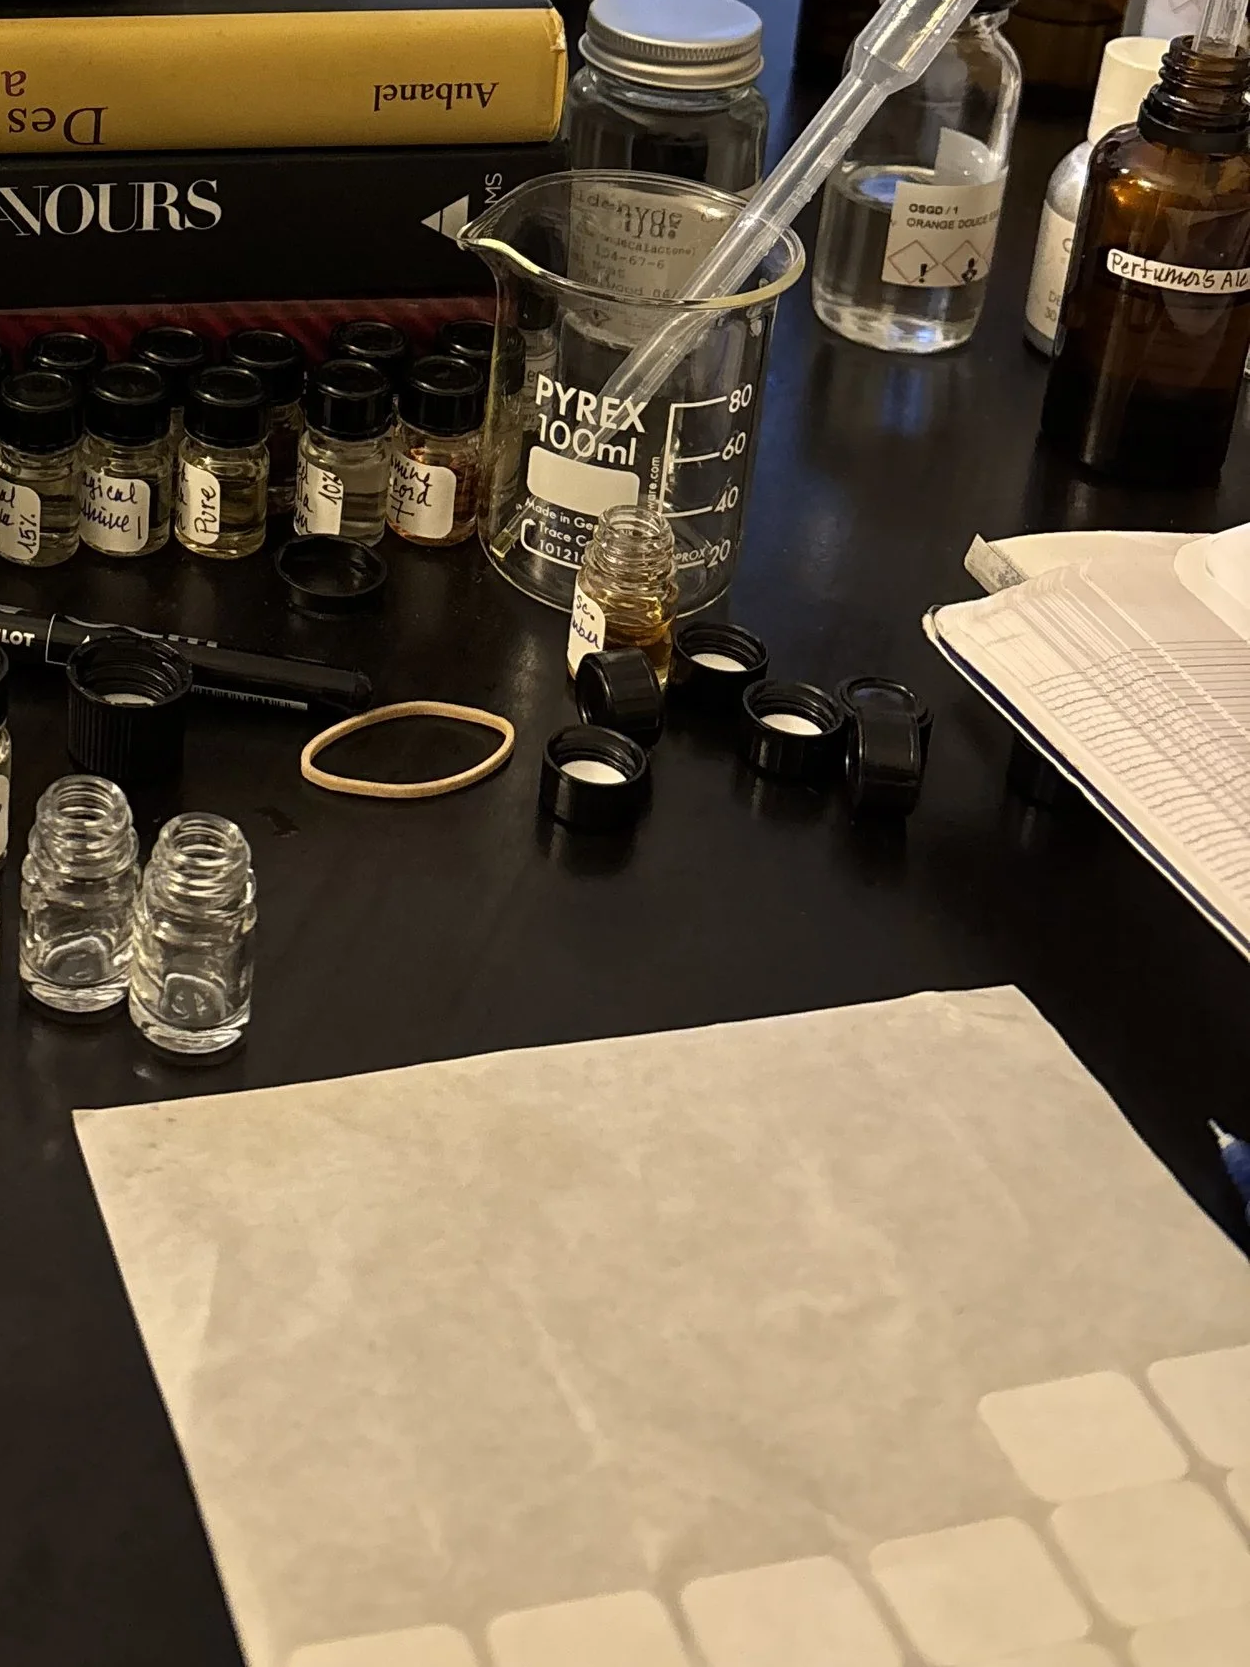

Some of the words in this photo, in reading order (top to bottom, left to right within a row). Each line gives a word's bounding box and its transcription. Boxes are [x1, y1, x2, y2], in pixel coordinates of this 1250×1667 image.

[373, 82, 500, 112] Aubanel
[8, 105, 109, 146] Des
[906, 217, 955, 230] ORANGE
[534, 373, 649, 433] PYREX
[728, 383, 753, 414] 80
[538, 413, 637, 466] 100ml
[721, 432, 747, 461] 60
[524, 497, 557, 520] Made
[560, 511, 570, 525] in
[713, 486, 739, 513] 40
[539, 521, 572, 543] Trace
[706, 539, 731, 569] 20
